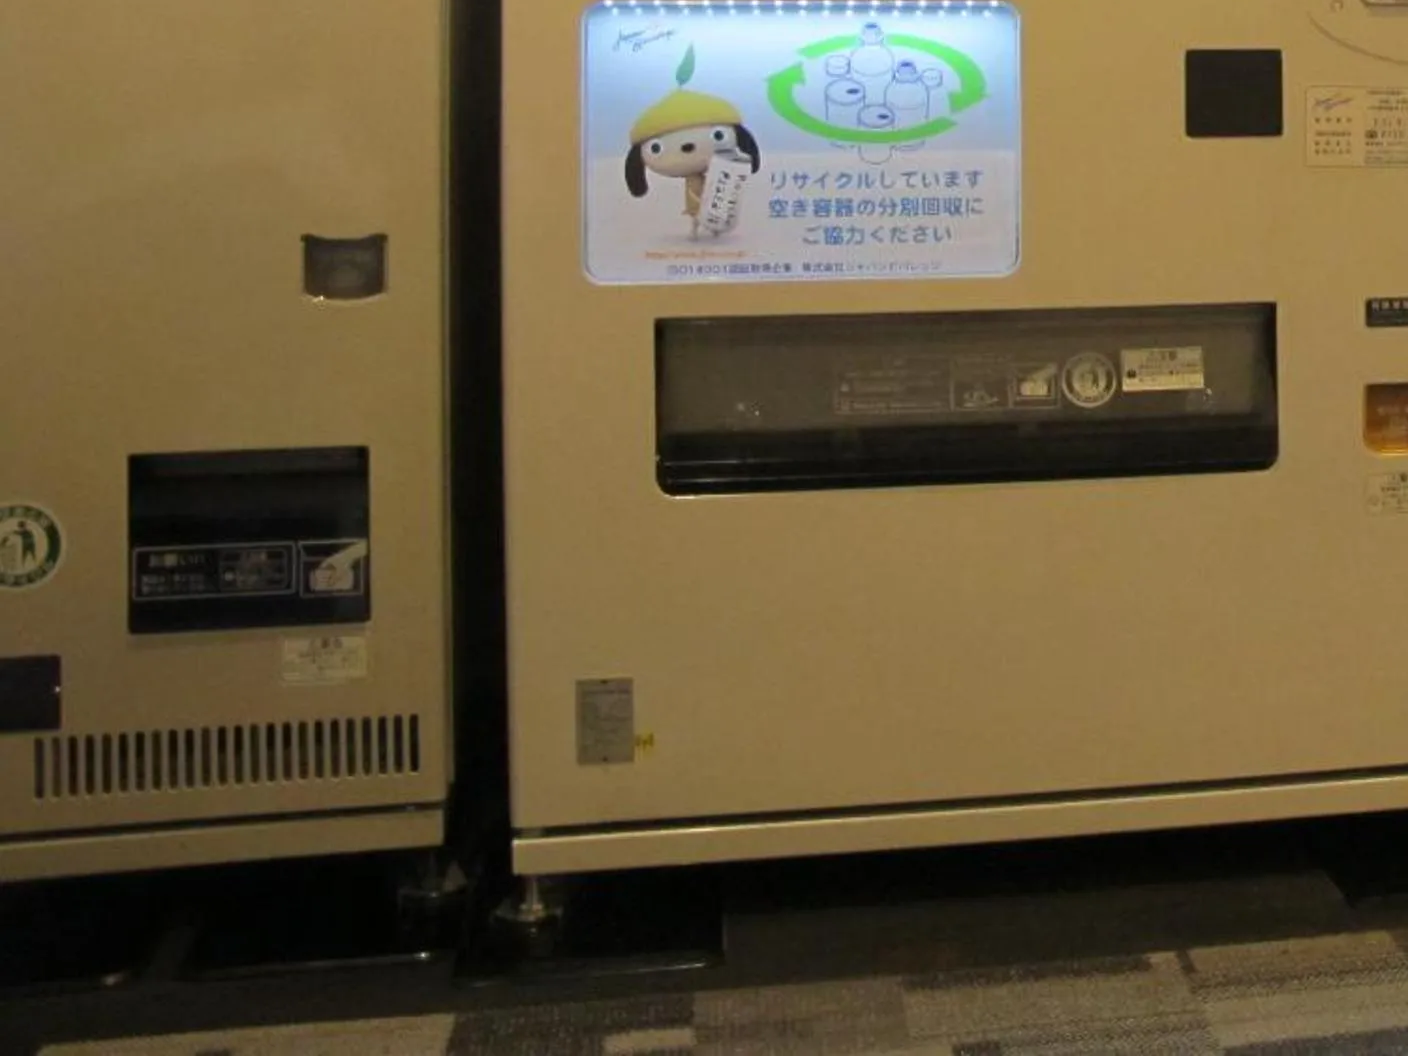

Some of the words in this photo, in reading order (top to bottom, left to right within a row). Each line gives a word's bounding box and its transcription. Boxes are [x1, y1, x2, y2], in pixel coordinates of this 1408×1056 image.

[769, 169, 985, 191] リサイクルしています
[768, 196, 985, 219] 空き容器の分別回収に
[803, 224, 954, 245] ご協力ください
